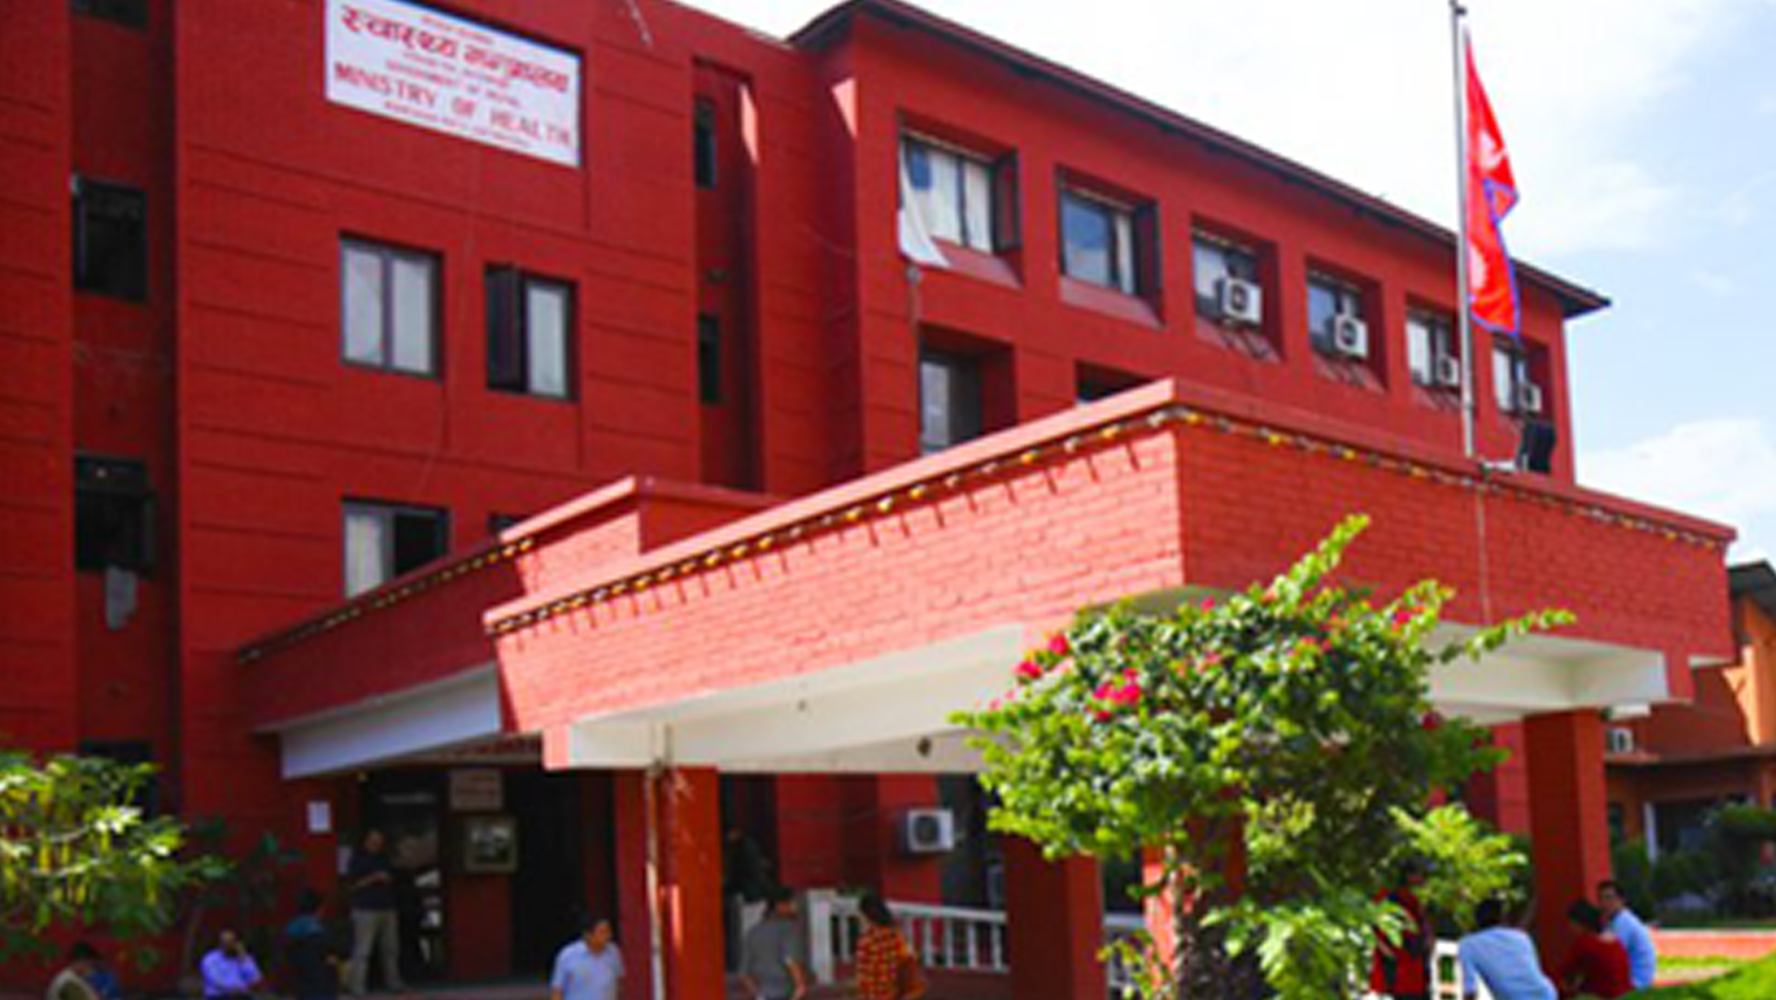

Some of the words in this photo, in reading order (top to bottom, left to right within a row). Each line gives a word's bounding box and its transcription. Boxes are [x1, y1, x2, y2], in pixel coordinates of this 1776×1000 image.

[335, 60, 436, 107] MINISTRY
[452, 96, 476, 118] OF
[490, 108, 571, 146] HEALTH
